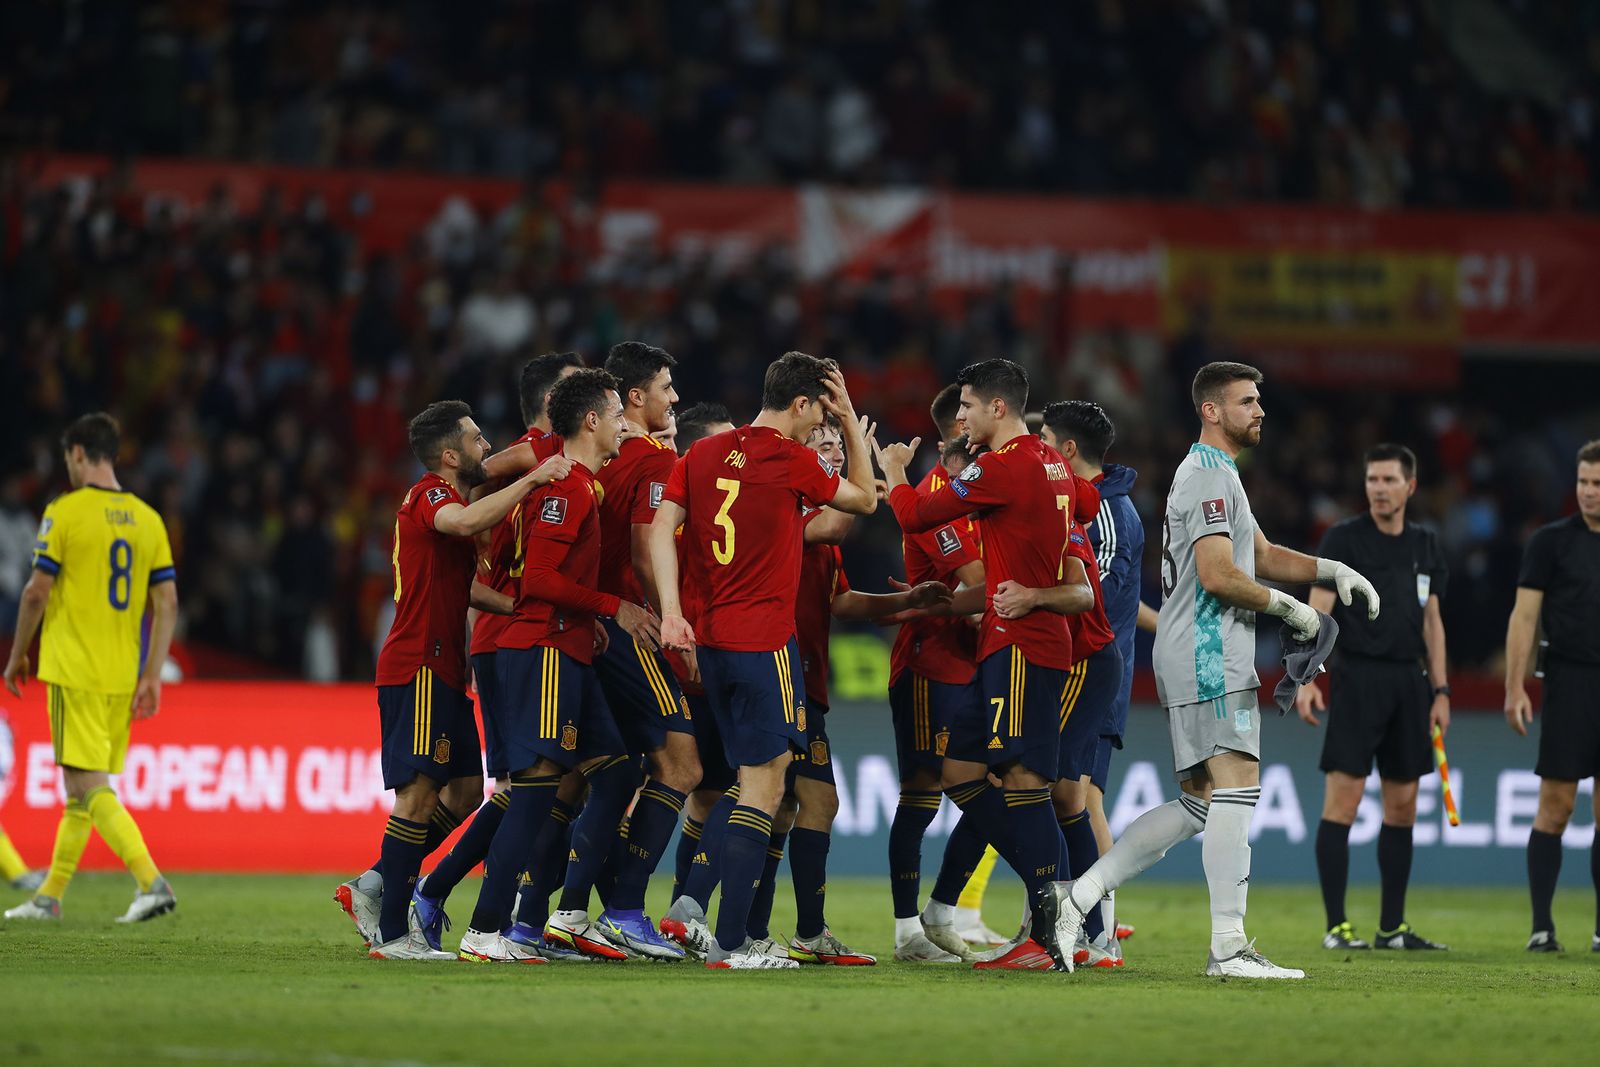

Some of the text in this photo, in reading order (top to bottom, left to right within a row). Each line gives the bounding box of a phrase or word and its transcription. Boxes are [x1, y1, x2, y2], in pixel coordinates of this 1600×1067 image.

[724, 450, 746, 469] PAU
[711, 477, 740, 565] 3
[1056, 494, 1069, 580] 7
[109, 538, 132, 612] 8
[990, 697, 1005, 733] 7
[26, 743, 288, 811] EOPEAN
[629, 843, 649, 860] RFEF
[1036, 864, 1057, 878] RFEF
